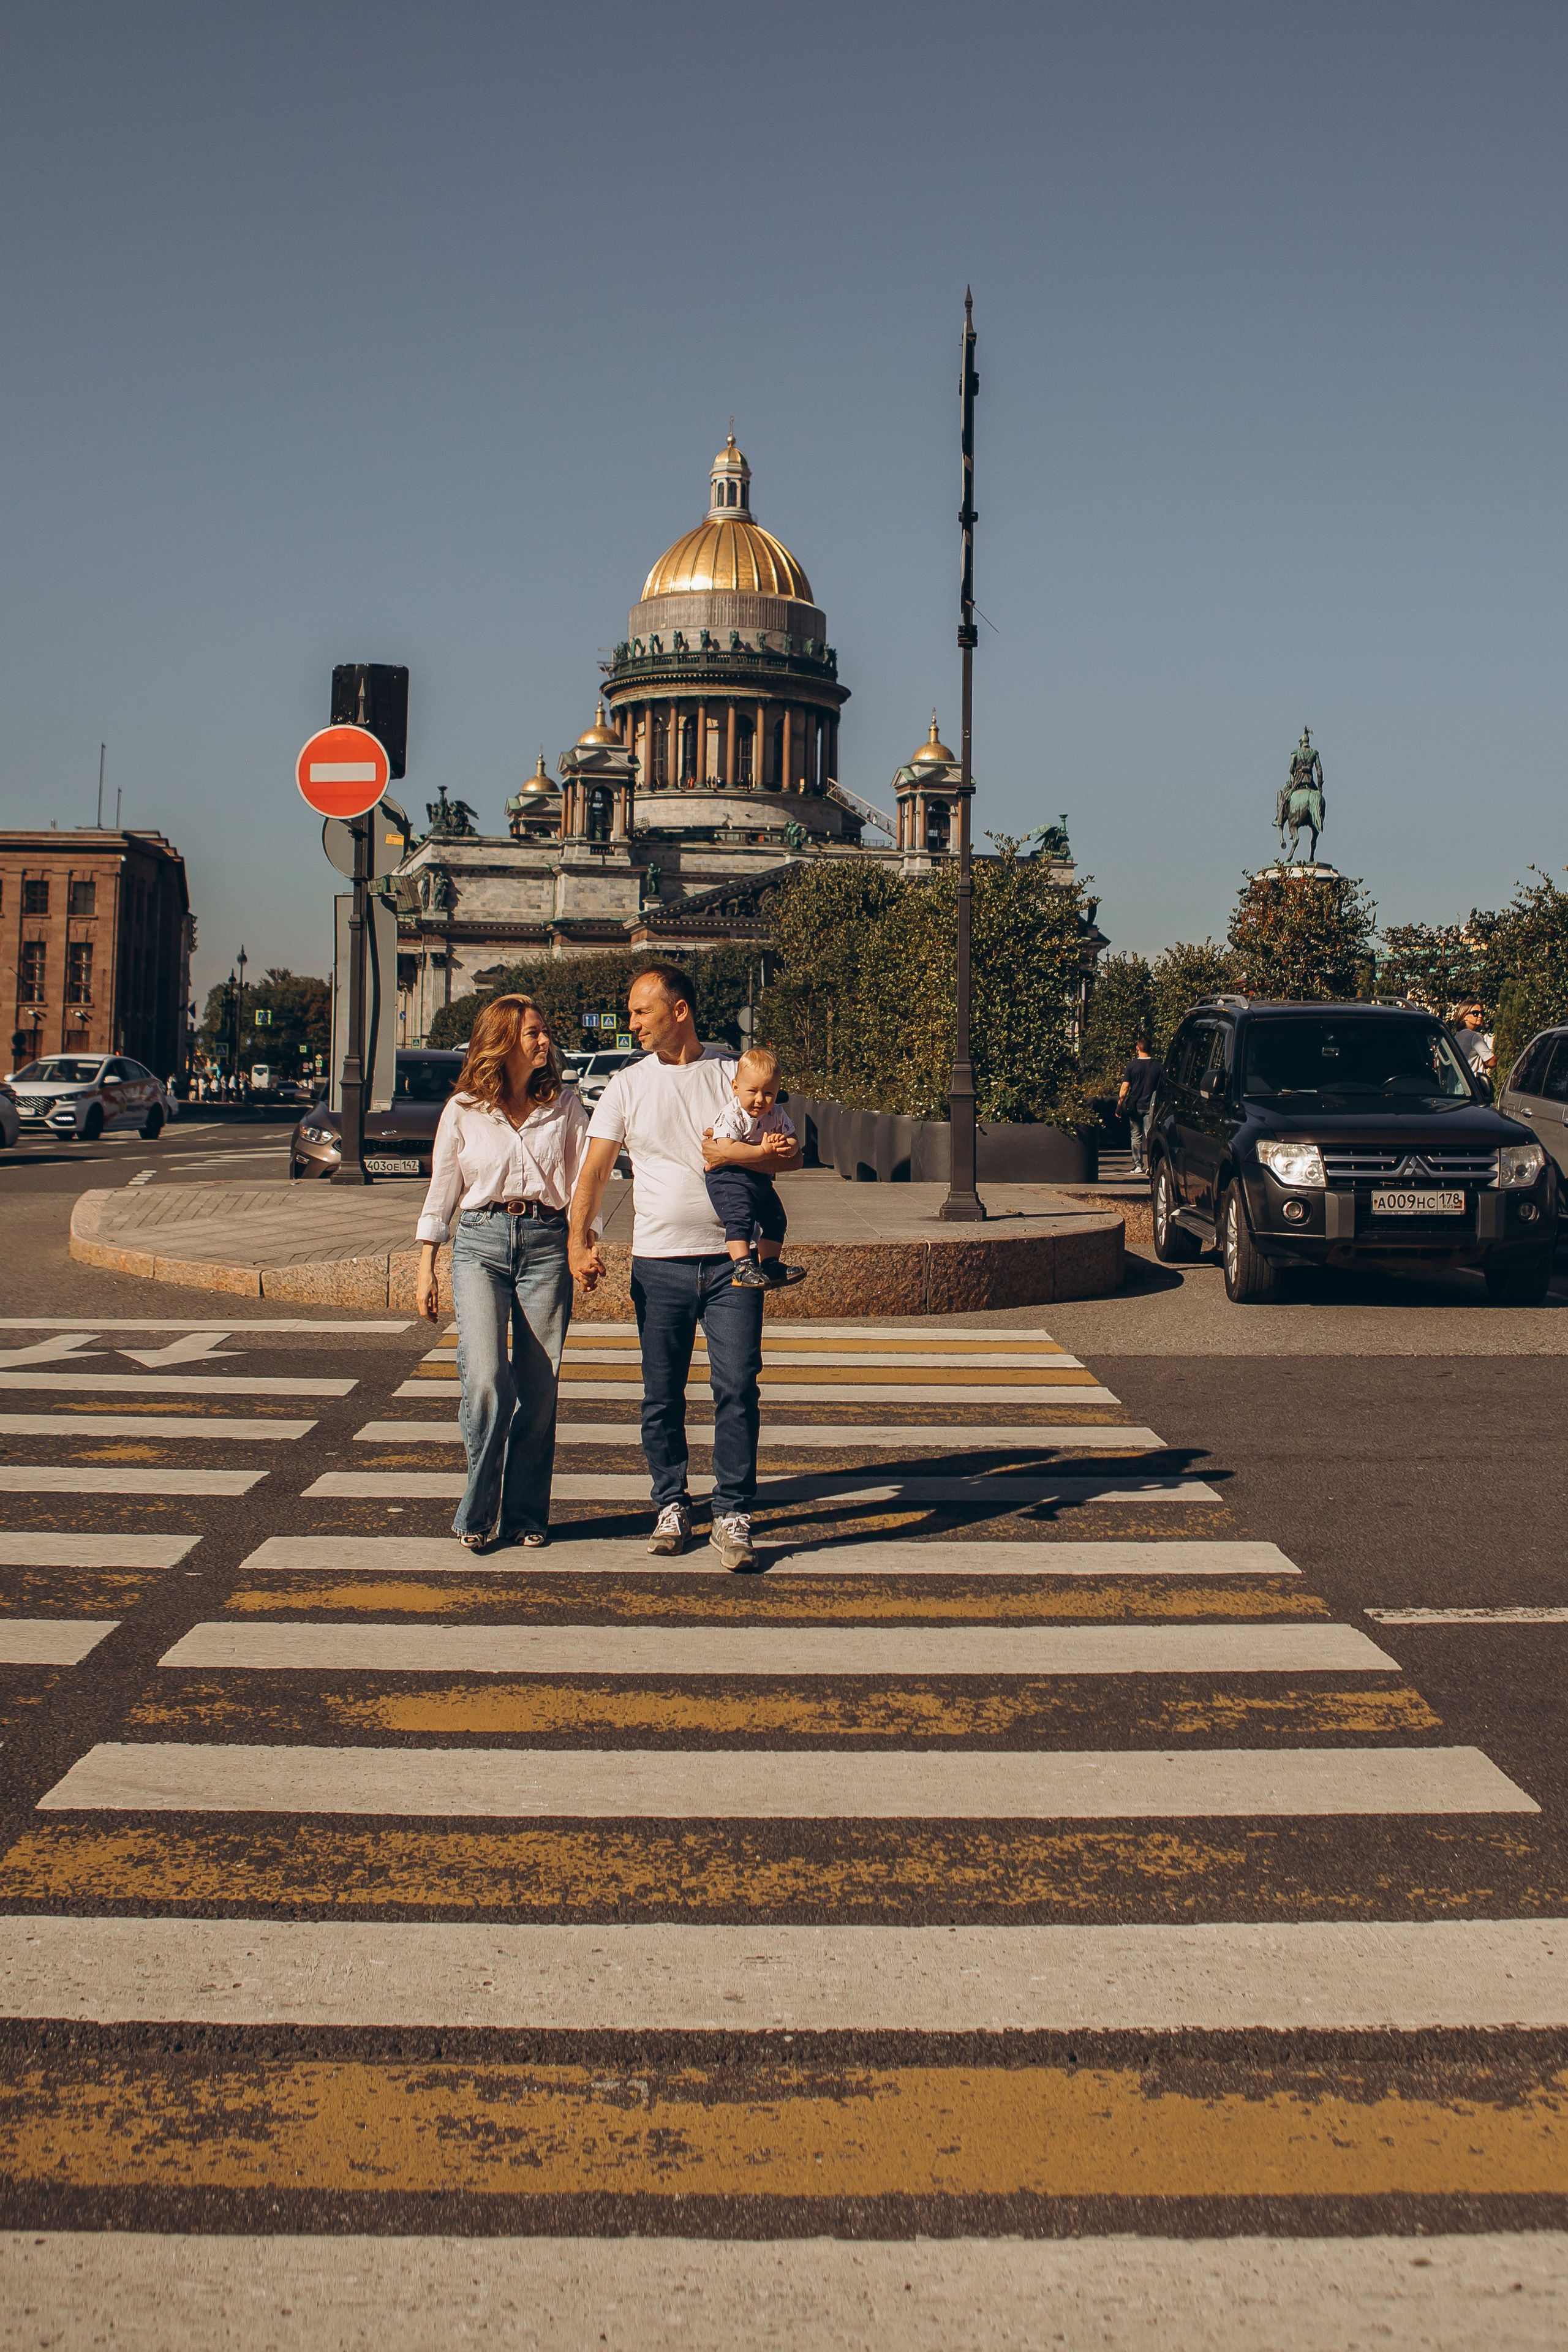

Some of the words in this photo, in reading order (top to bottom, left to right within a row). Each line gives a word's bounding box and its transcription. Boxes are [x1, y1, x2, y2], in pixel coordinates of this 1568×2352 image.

[367, 1161, 400, 1170] 403OE
[1378, 1194, 1434, 1208] A009HC
[1439, 1193, 1460, 1204] 178
